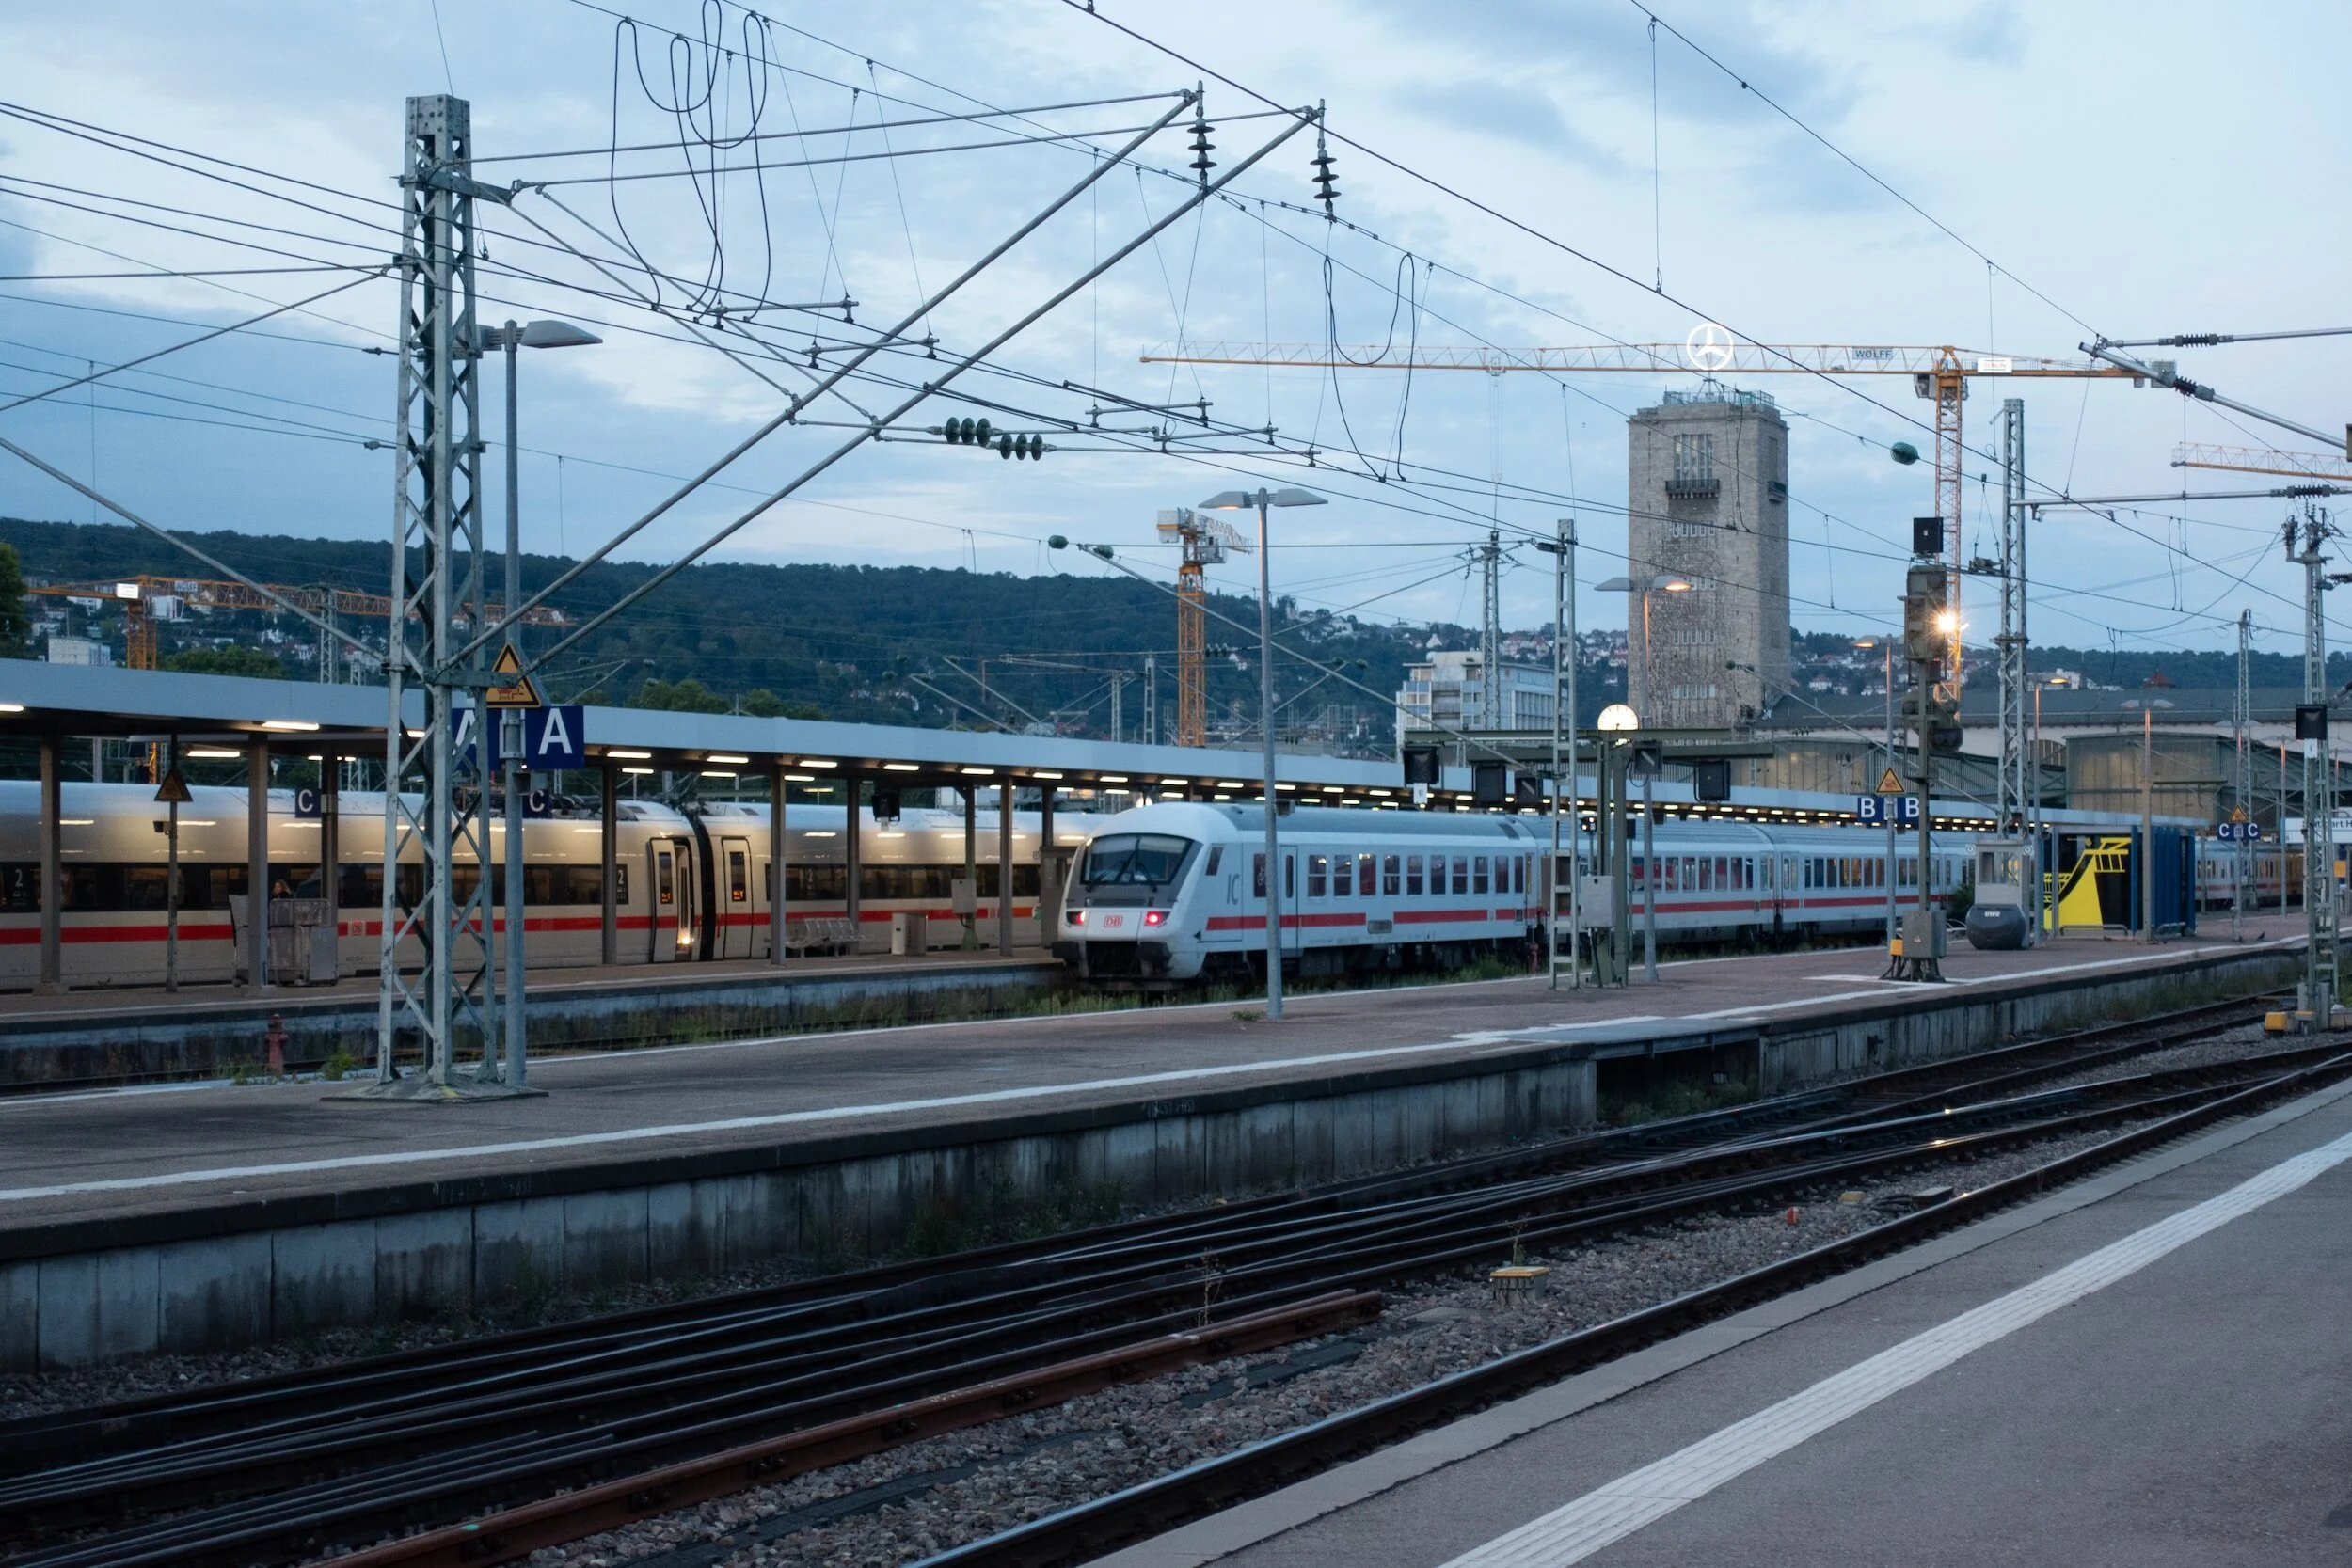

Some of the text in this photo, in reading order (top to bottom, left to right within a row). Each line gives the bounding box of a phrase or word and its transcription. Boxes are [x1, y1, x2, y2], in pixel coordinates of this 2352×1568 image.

[1855, 349, 1892, 358] WOLFF
[538, 707, 573, 755] A
[298, 788, 313, 812] C
[529, 789, 545, 813] C
[1861, 797, 1876, 818] B
[1905, 797, 1919, 818] B
[2218, 823, 2229, 837] C
[2248, 823, 2258, 837] C
[14, 868, 24, 887] 2
[618, 869, 624, 884] 2
[1227, 873, 1240, 905] IC
[1105, 916, 1121, 927] DB
